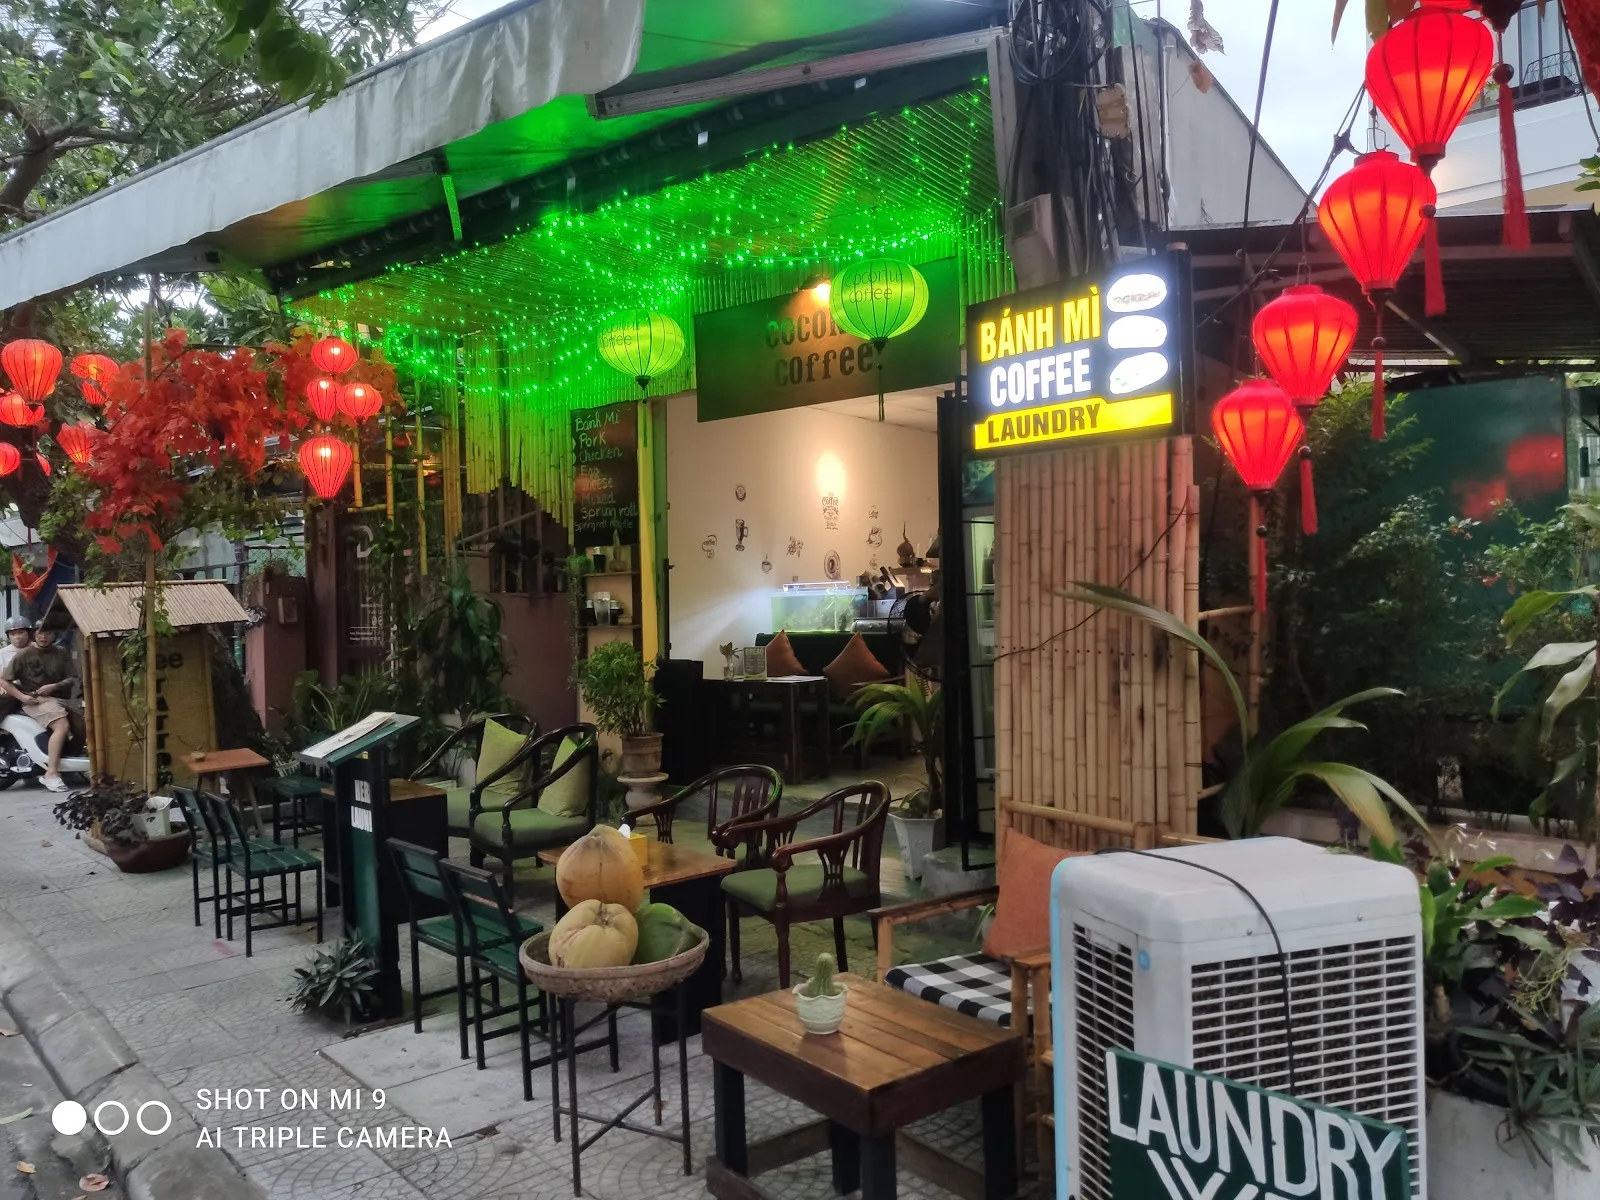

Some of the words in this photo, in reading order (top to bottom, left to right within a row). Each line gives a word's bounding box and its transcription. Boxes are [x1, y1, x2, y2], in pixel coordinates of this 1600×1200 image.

[849, 287, 893, 304] coffee
[979, 308, 1055, 363] BÁNH
[1062, 285, 1101, 344] MÌ
[774, 341, 874, 387] coffee
[989, 348, 1092, 408] COFFEE
[987, 402, 1101, 444] LAUNDRY
[1106, 1051, 1402, 1200] LAUNDRY
